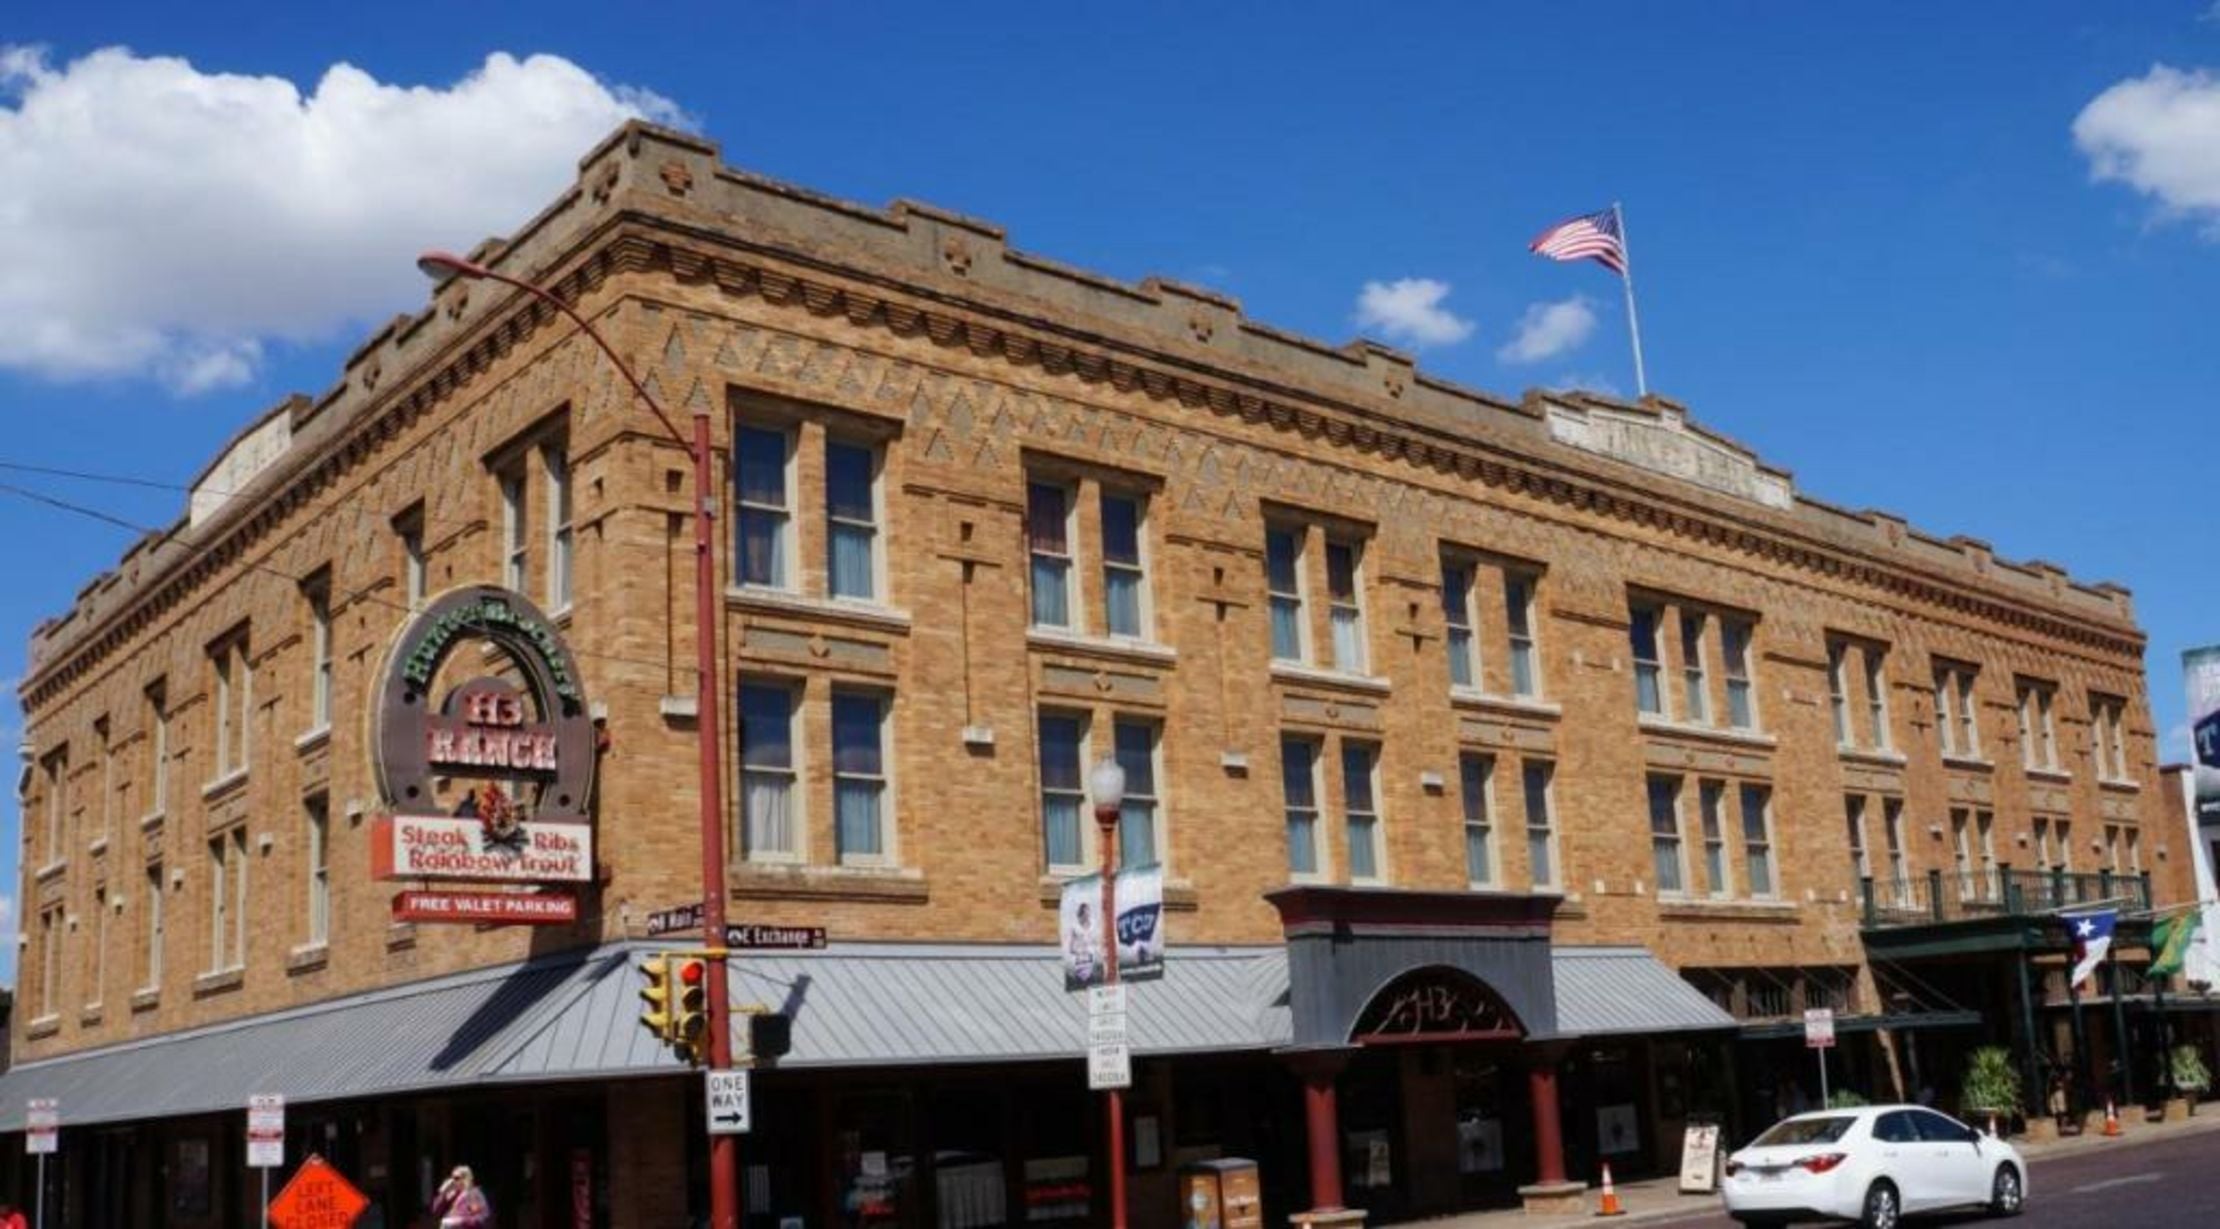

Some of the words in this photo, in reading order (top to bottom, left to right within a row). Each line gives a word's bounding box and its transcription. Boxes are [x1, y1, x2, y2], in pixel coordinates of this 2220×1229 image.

[428, 728, 556, 769] RANCH
[402, 826, 468, 847] Steak
[534, 832, 579, 850] Ribs
[409, 850, 512, 870] Rainbow
[519, 854, 579, 873] Trout
[410, 897, 449, 911] FREE
[455, 899, 500, 912] VALET
[506, 900, 571, 914] PARKING
[755, 927, 809, 948] Exchange
[1119, 914, 1155, 939] TCU
[711, 1075, 744, 1092] ONE
[712, 1092, 744, 1109] WAY
